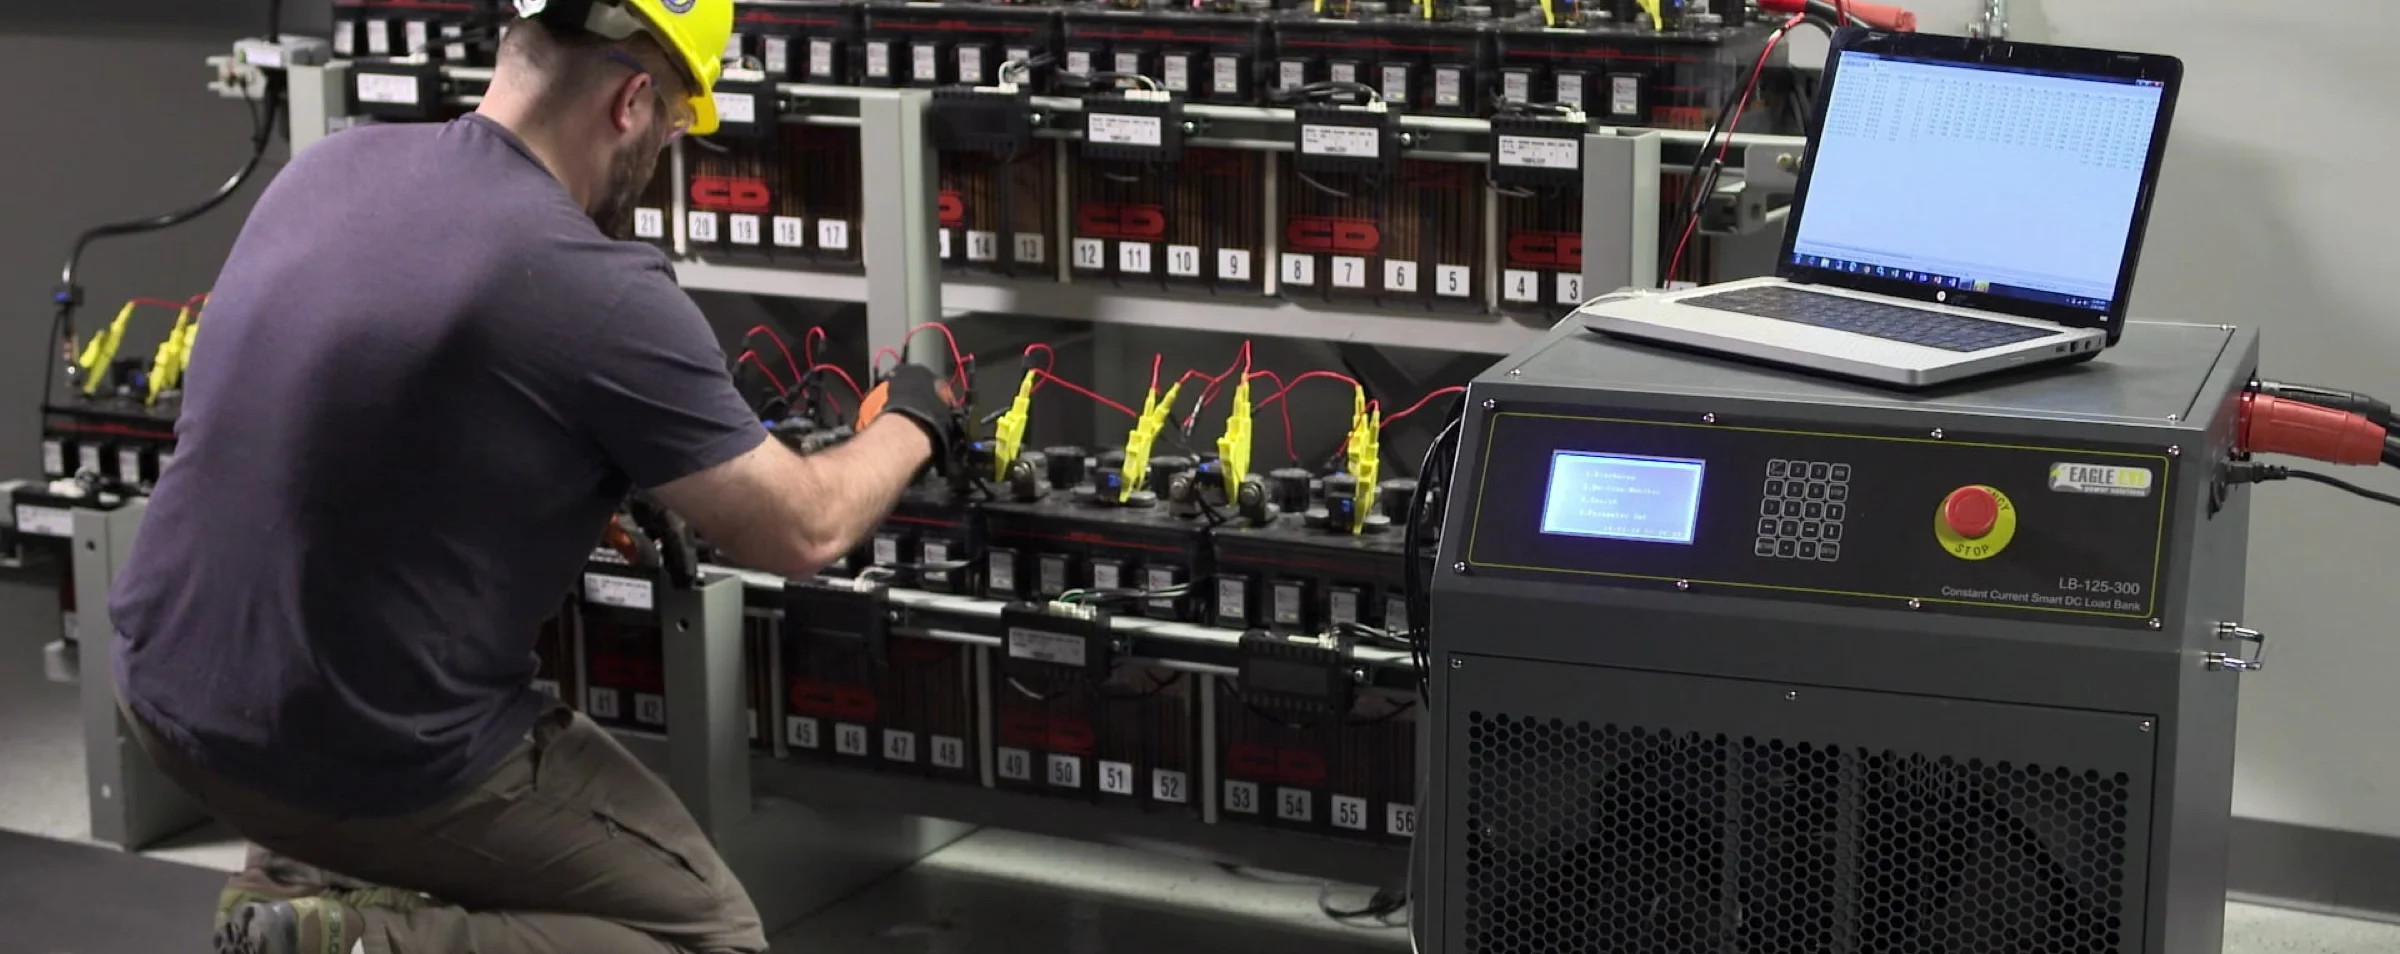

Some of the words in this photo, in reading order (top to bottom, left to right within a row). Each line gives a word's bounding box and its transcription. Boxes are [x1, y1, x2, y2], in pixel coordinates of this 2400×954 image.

[640, 213, 656, 232] 21
[694, 220, 710, 237] 20
[738, 223, 752, 240] 19
[781, 223, 796, 241] 18
[825, 227, 840, 245] 17
[975, 237, 990, 256] 14
[1022, 240, 1037, 259] 13
[1081, 244, 1096, 265] 12
[1128, 248, 1143, 268] 11
[1176, 251, 1191, 271] 10
[1230, 255, 1238, 275] 9
[1293, 259, 1302, 279] 8
[1344, 262, 1354, 283] 7
[1396, 266, 1405, 286] 6
[1449, 271, 1458, 291] 5
[1516, 276, 1525, 297] 4
[1569, 279, 1578, 300] 3
[2069, 466, 2115, 484] EAGLE
[1955, 543, 1990, 557] STOP
[2058, 577, 2140, 596] LB-125-300
[1940, 585, 1988, 599] Constant
[1990, 590, 2029, 603] Current
[2031, 593, 2063, 607] Smart
[2065, 595, 2082, 607] DC
[2085, 597, 2111, 610] Load
[2114, 599, 2141, 612] Bank
[795, 722, 811, 744] 45
[843, 729, 860, 752] 46
[892, 736, 909, 758] 47
[939, 742, 956, 764] 48
[1006, 753, 1022, 776] 49
[1055, 761, 1073, 783] 50
[1106, 767, 1124, 790] 51
[1160, 775, 1178, 798] 52
[1232, 785, 1250, 809] 53
[1285, 793, 1304, 816] 54
[1339, 802, 1359, 825] 55
[1395, 810, 1415, 833] 56
